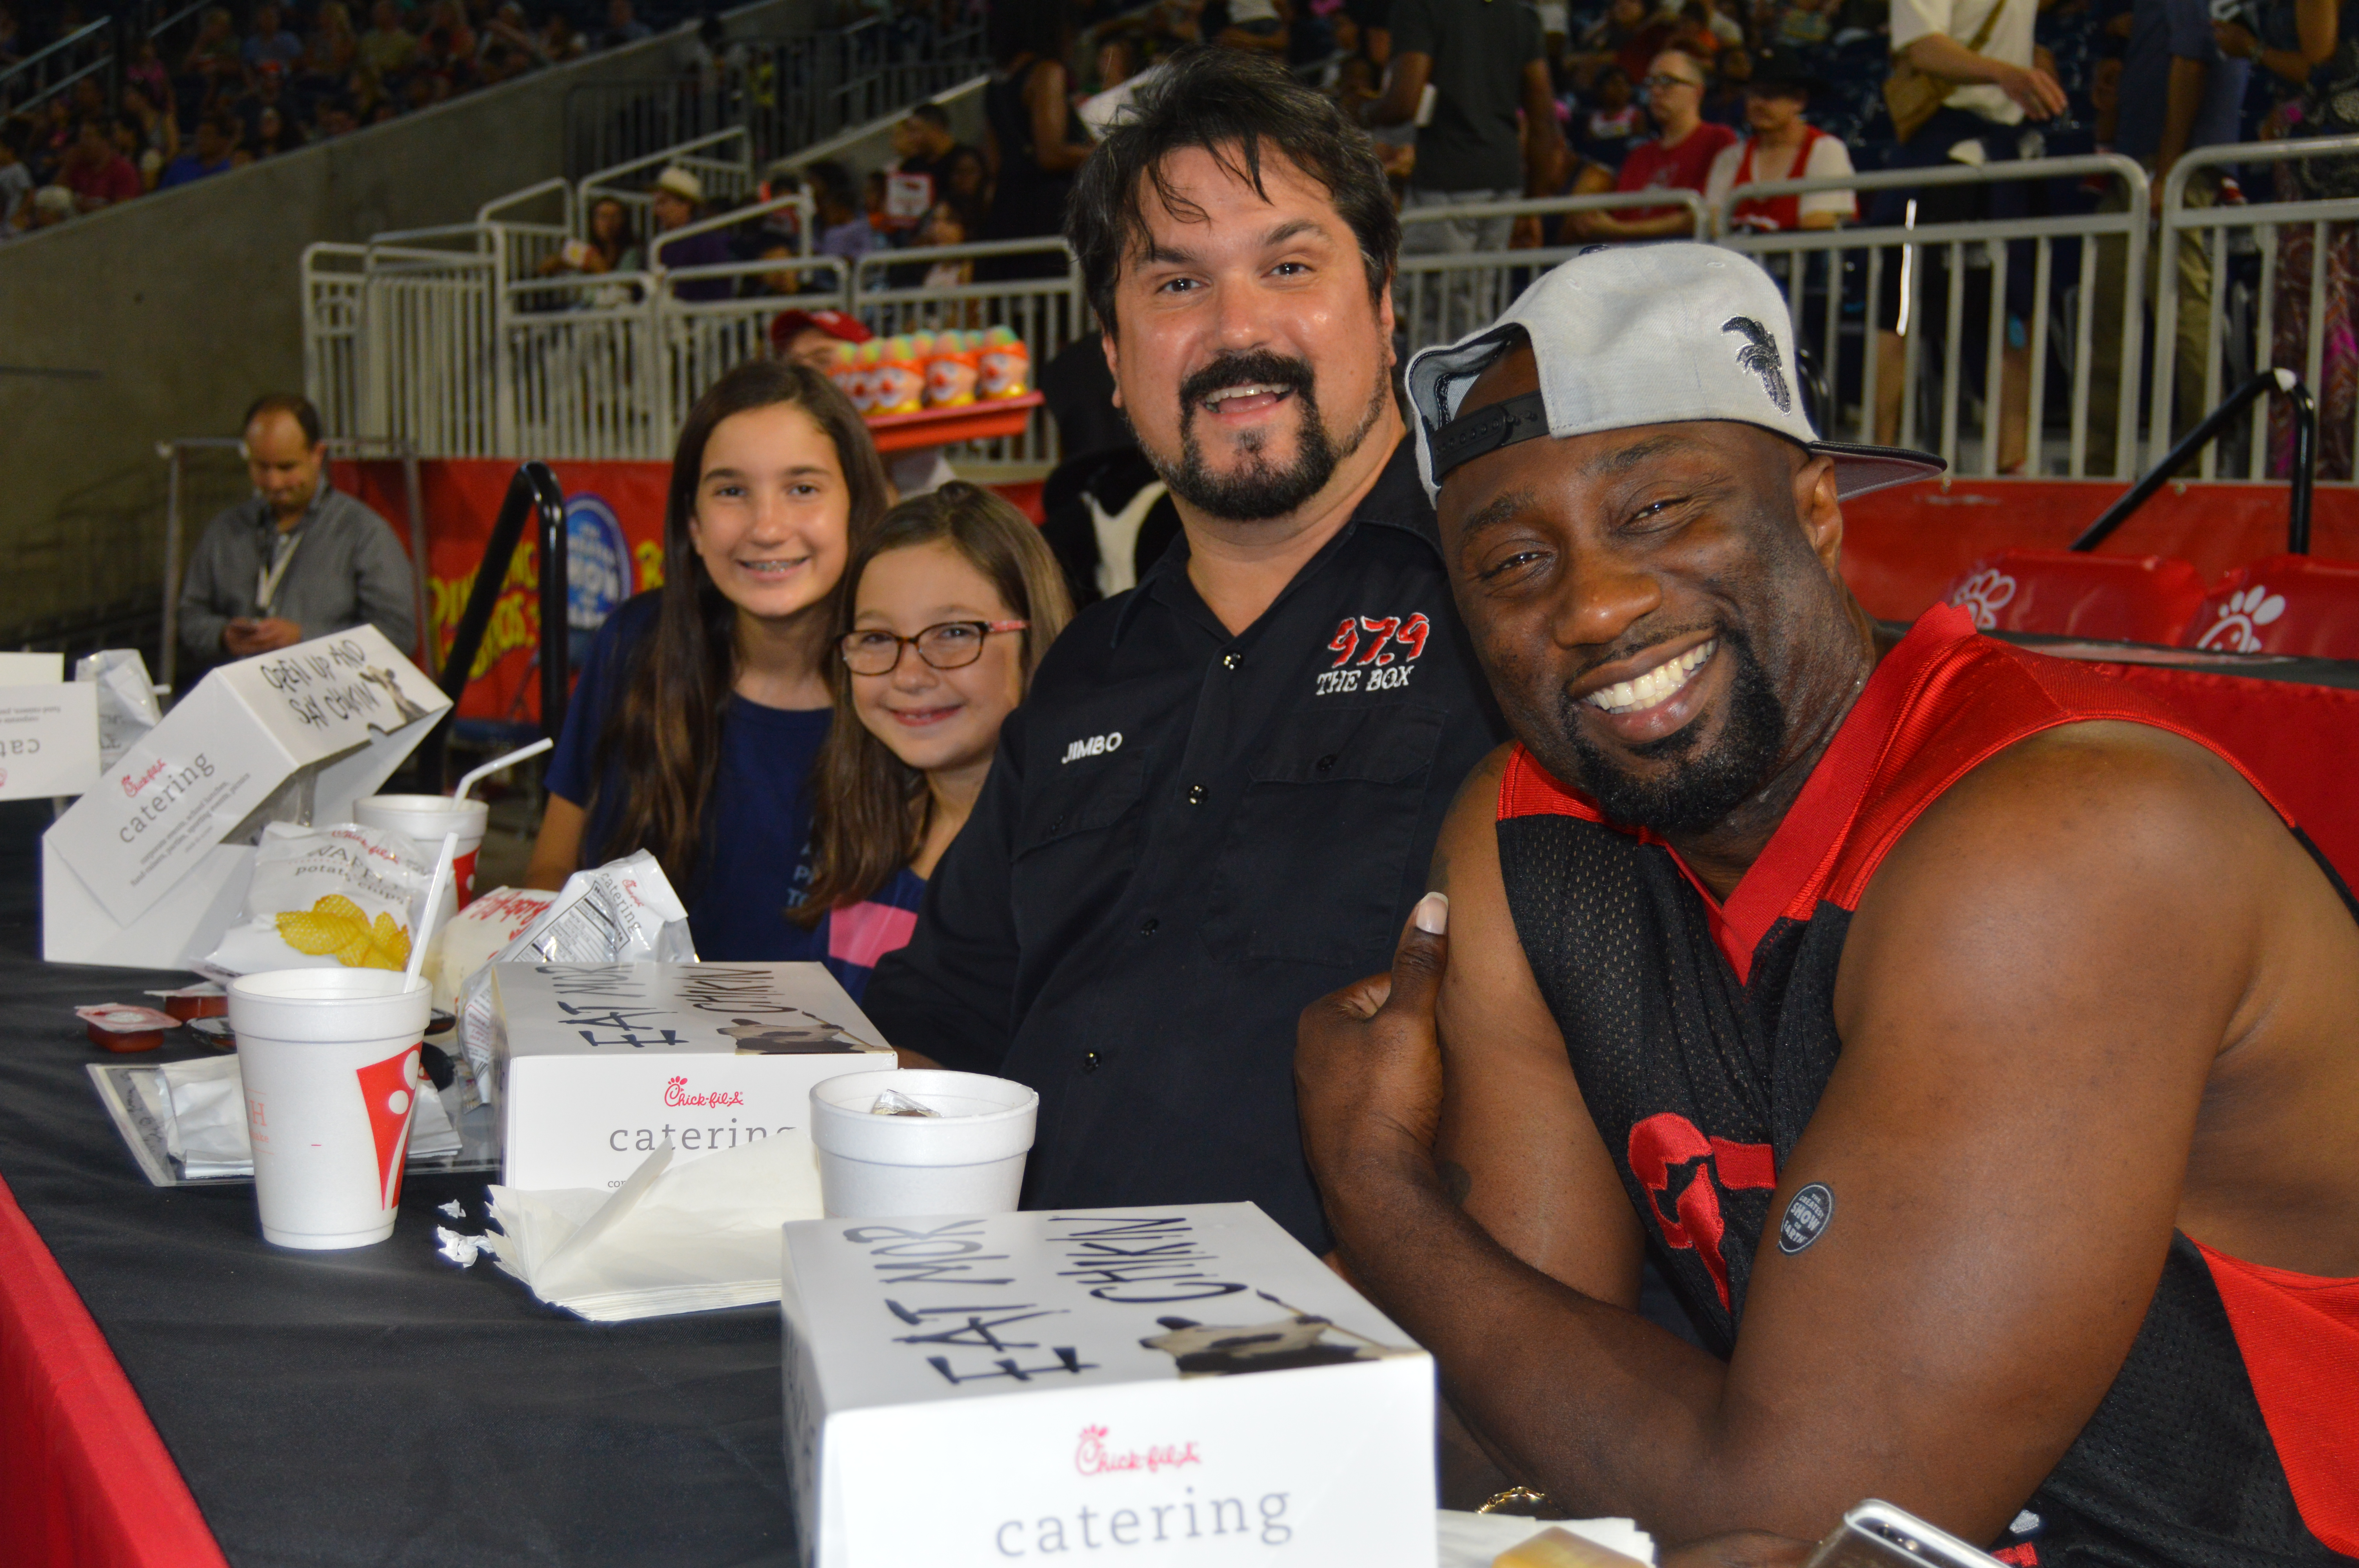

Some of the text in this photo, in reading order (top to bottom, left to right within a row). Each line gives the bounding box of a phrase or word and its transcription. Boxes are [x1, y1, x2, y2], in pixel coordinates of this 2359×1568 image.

[260, 639, 365, 692] OPEN UP AND
[1316, 665, 1414, 695] THE BOX
[289, 681, 380, 731] SAY CHIKIN
[1061, 732, 1123, 764] JIMBO
[120, 753, 214, 843] catering
[601, 873, 642, 934] catering
[535, 965, 689, 1048] EAT MOR
[672, 965, 798, 1013] CHIKIN
[664, 1076, 744, 1109] Chick-fil-A
[609, 1118, 796, 1151] caterin
[1790, 1202, 1820, 1231] SHOW
[1799, 1195, 1824, 1218] GREATEST
[1812, 1193, 1821, 1204] THE
[1784, 1220, 1805, 1243] EARTH
[1794, 1221, 1802, 1230] ON
[1045, 1216, 1249, 1303] CHIKIN
[842, 1219, 1101, 1385] EAT MOR
[1076, 1425, 1201, 1476] Chick-fil-A
[995, 1486, 1292, 1558] catering
